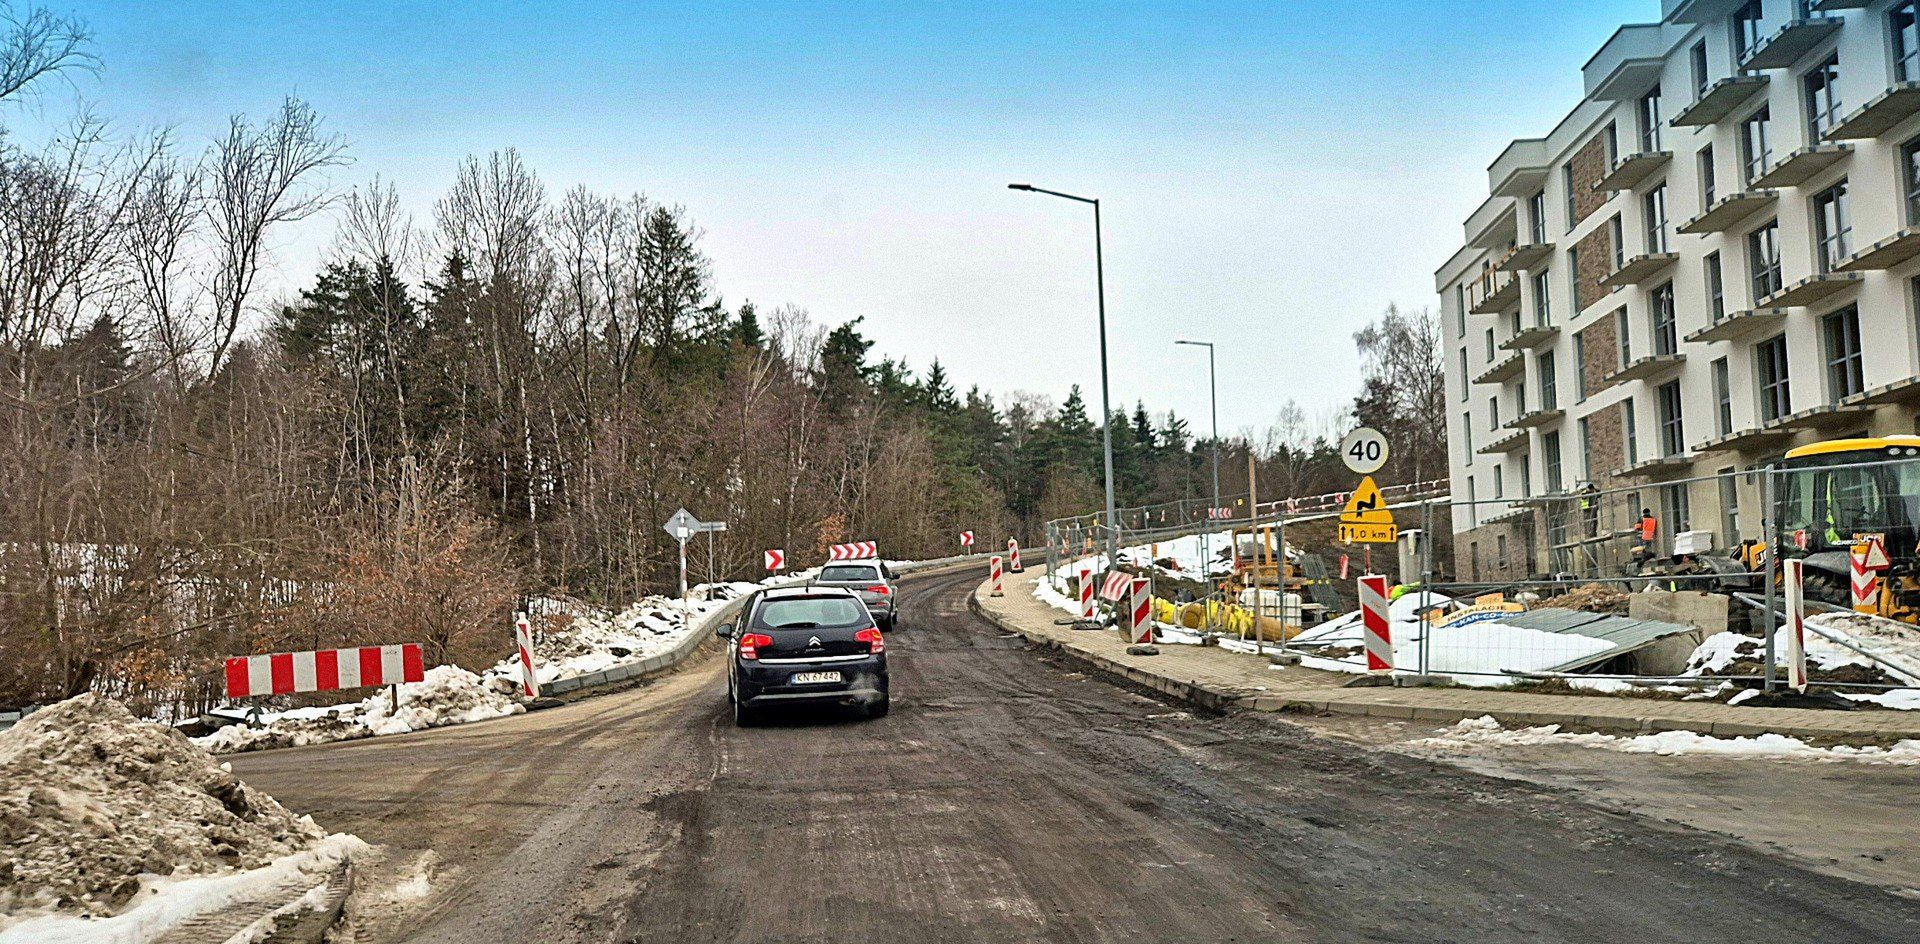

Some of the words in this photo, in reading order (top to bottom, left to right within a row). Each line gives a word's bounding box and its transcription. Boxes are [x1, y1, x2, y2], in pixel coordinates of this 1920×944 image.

[1349, 440, 1381, 461] 40
[1371, 531, 1387, 539] km
[798, 673, 810, 682] KN
[812, 672, 839, 681] 67442
